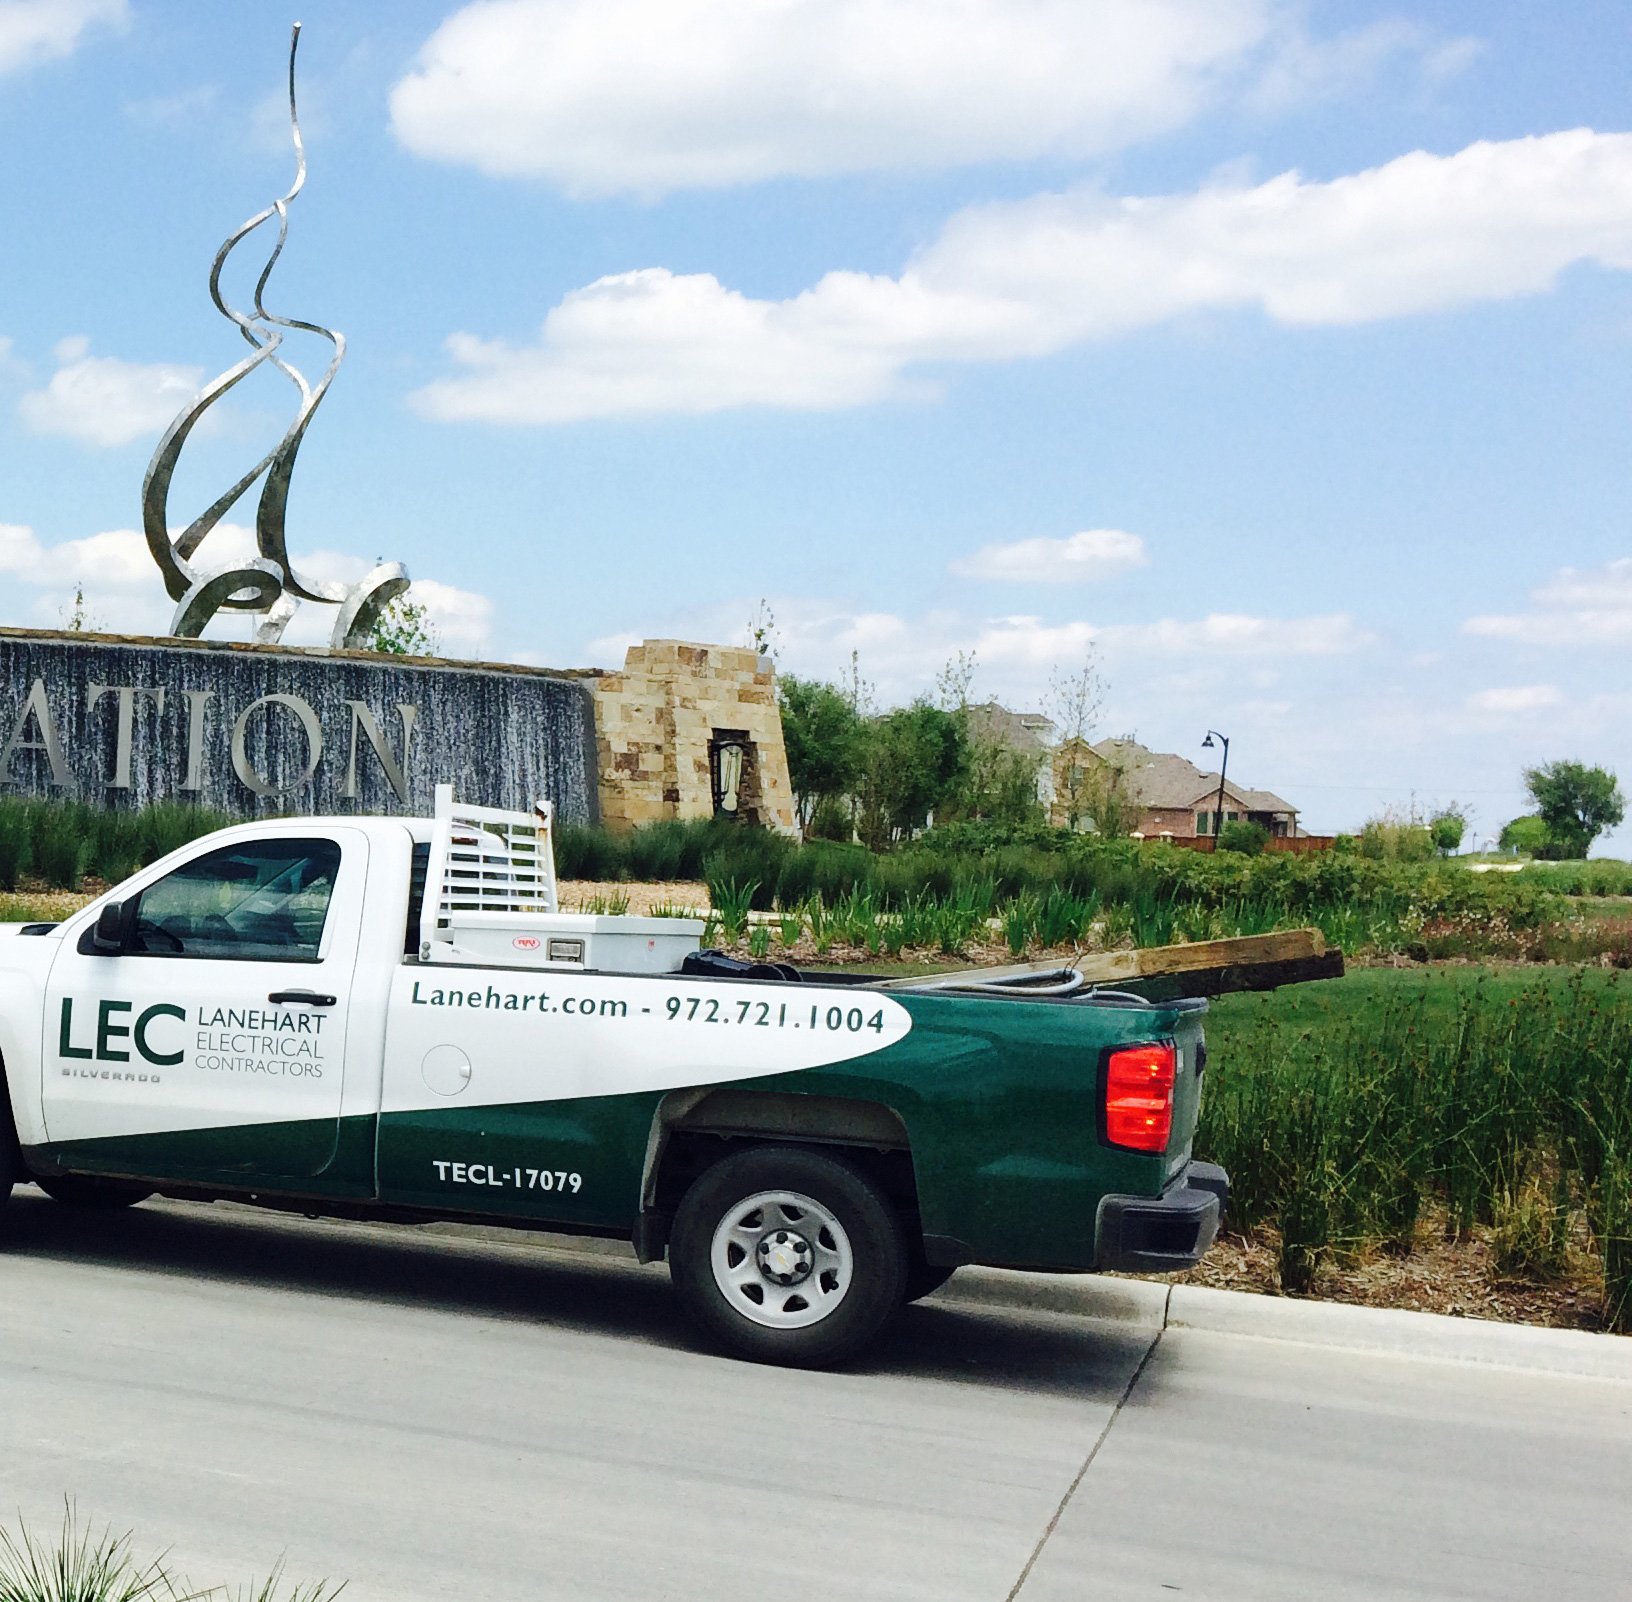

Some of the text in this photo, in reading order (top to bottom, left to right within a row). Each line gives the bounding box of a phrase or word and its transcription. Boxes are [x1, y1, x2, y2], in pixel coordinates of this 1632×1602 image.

[197, 1006, 328, 1034] LANEHART
[411, 981, 628, 1018] Lanehart.com
[665, 996, 885, 1034] 972.721.1004
[58, 997, 187, 1066] LEC
[196, 1031, 325, 1059] ELECTRICAL
[61, 1067, 161, 1084] SILVERADO
[194, 1054, 323, 1078] CONTRACTORS
[432, 1160, 582, 1194] TECL-17079
